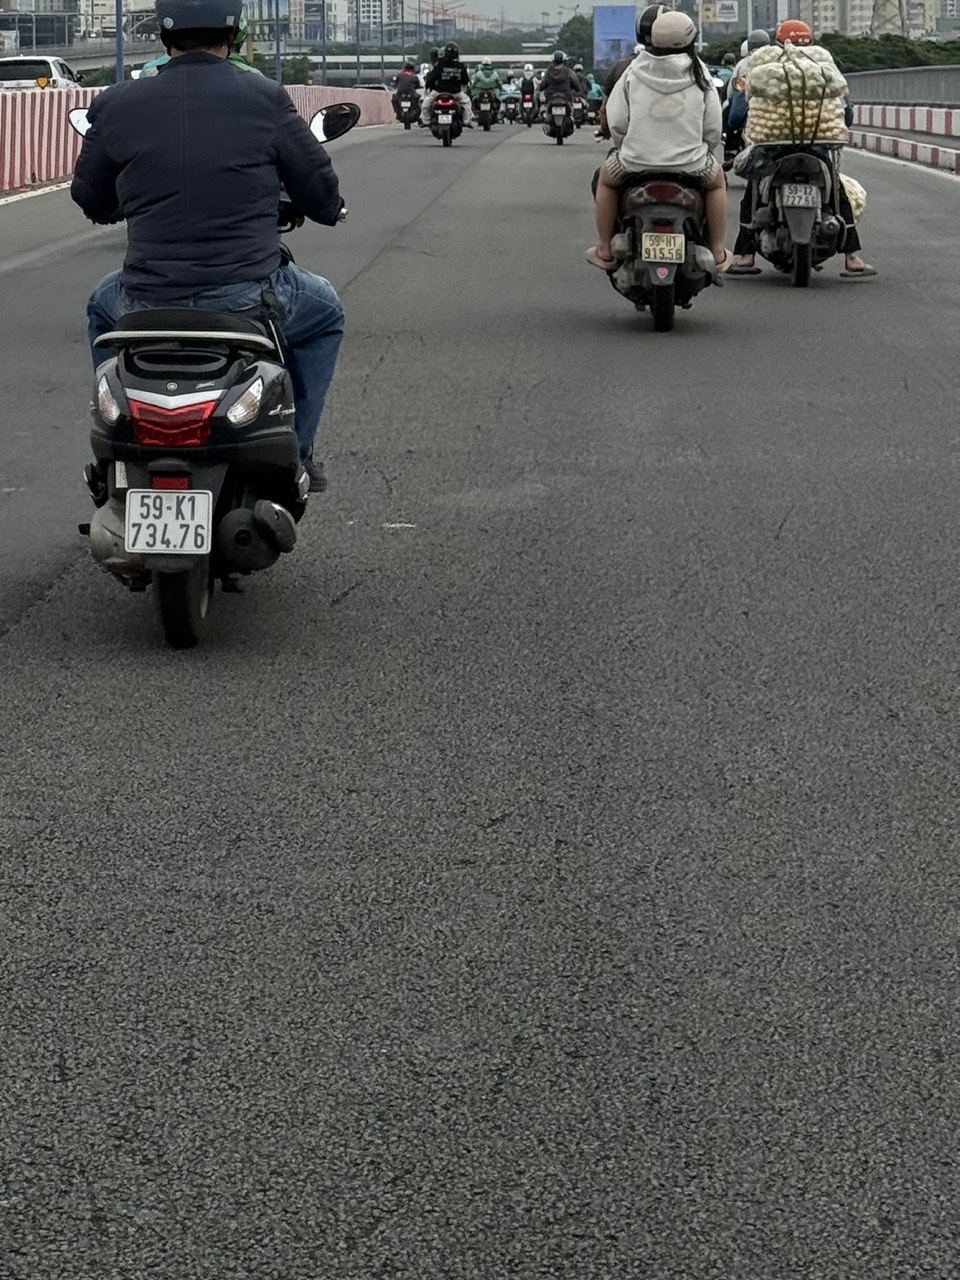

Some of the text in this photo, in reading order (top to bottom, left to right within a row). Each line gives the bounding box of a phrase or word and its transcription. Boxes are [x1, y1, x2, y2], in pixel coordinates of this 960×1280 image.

[649, 235, 676, 247] 59-H1
[139, 494, 196, 521] 59-K1
[131, 523, 206, 549] 734.76
